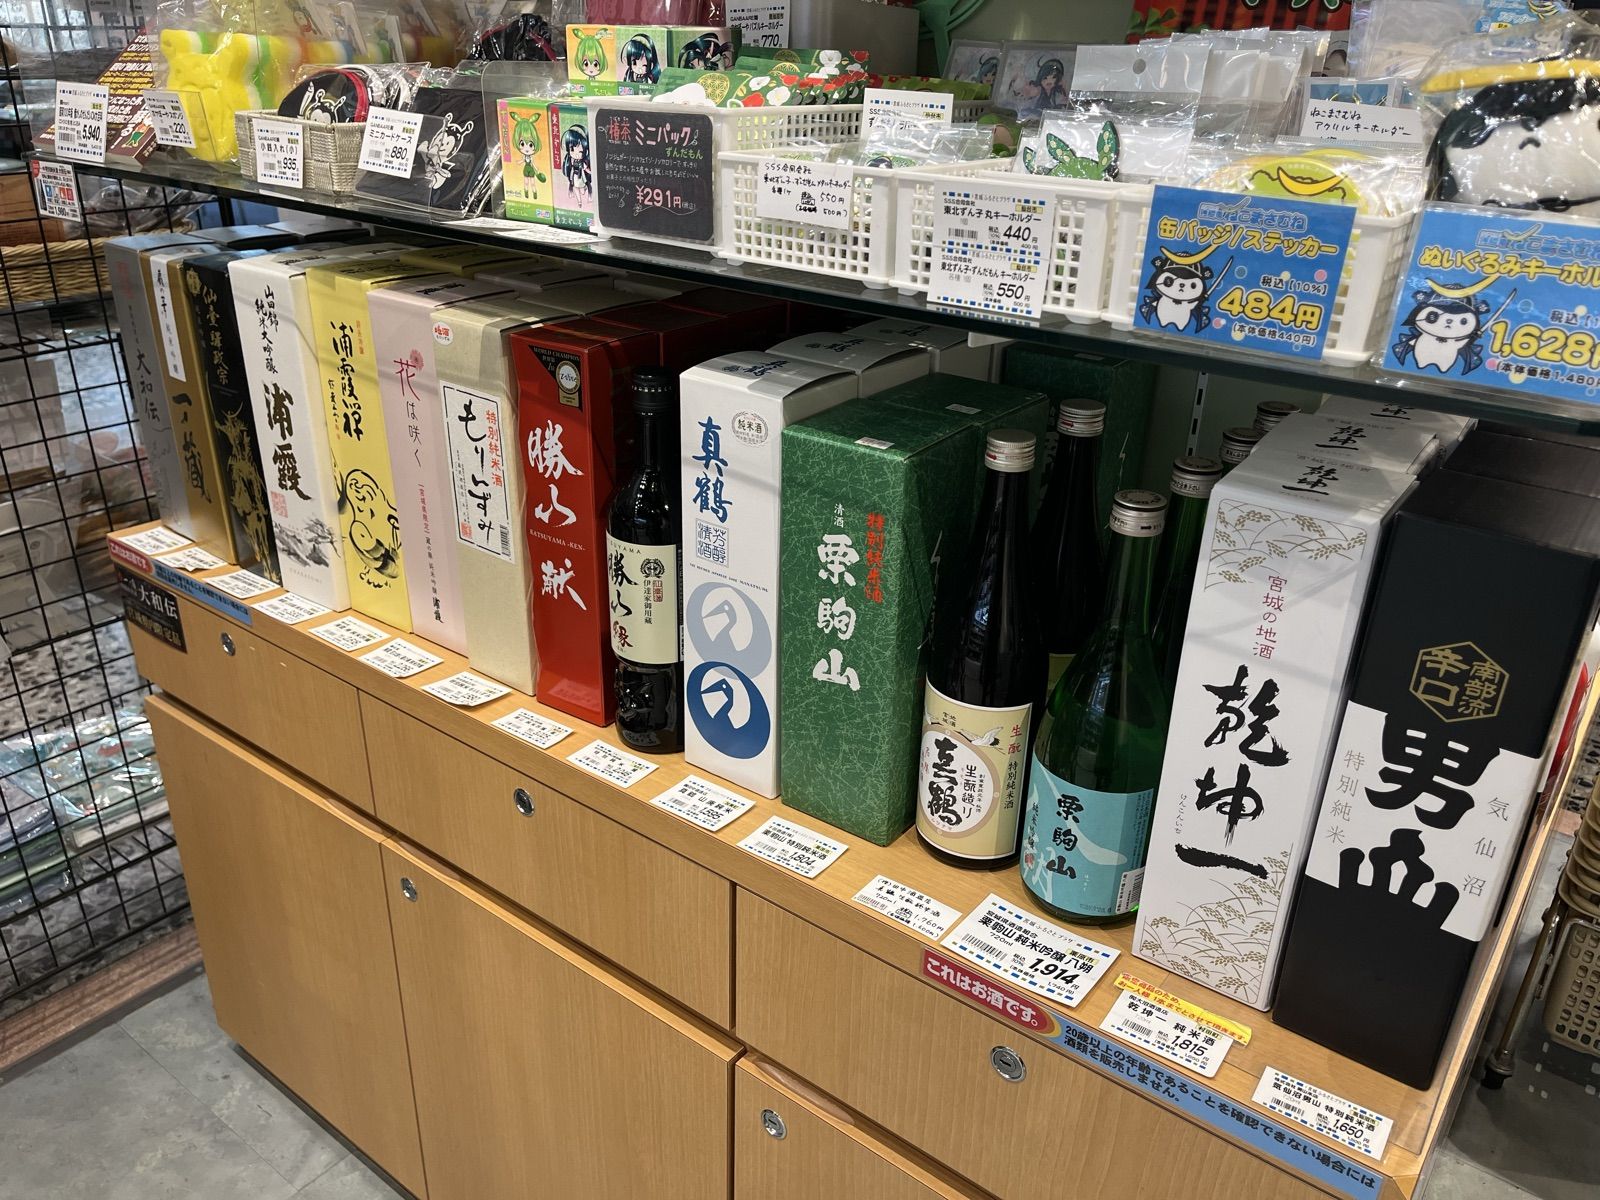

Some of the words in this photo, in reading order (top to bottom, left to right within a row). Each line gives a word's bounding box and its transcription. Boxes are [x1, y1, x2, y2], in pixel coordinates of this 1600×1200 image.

[82, 124, 100, 141] 5,940
[173, 122, 186, 134] 220
[608, 120, 631, 141] 椿茶
[635, 120, 691, 147] ミニパック
[1310, 107, 1361, 120] ねこまさむね
[369, 129, 413, 144] ミニカードケース
[390, 146, 408, 160] 880
[665, 147, 704, 160] ずんだもん
[282, 157, 297, 171] 935
[820, 192, 845, 204] 550円
[943, 205, 984, 219] 東北ずん子
[985, 209, 1042, 223] 丸キーホルダー
[1001, 271, 1035, 281] キーホルダー
[264, 285, 279, 333] 山田錦
[1217, 287, 1323, 331] 484円
[254, 298, 279, 375] 純米大吟醸
[1233, 322, 1316, 346] (本体価格440円)
[136, 351, 161, 422] 大和伝
[393, 358, 422, 468] 花は咲く
[737, 419, 762, 434] 純米酒
[263, 382, 312, 500] 浦霞
[486, 410, 503, 487] 特別純米酒
[527, 420, 584, 528] 勝山
[692, 415, 733, 524] 真鶴
[529, 529, 567, 546] KATSUYAMA
[834, 503, 845, 528] 清酒
[865, 512, 885, 604] 特別純米酒
[139, 584, 178, 620] 大和伝
[812, 533, 861, 691] 栗駒山
[1253, 575, 1288, 660] 宮城の地酒
[1421, 648, 1471, 707] 辛口
[1457, 661, 1501, 718] 南部流
[1003, 761, 1019, 809] 特別純米酒
[1175, 664, 1291, 880] 乾坤一
[699, 807, 724, 820] 1,595
[1327, 749, 1365, 845] 特別純米
[762, 829, 786, 843] 栗駒山
[786, 839, 828, 861] 特別純米酒
[789, 851, 817, 866] 1,804
[1046, 793, 1084, 880] 栗駒山
[1463, 796, 1512, 898] 気仙沼
[978, 915, 1017, 939] 栗駒山
[1013, 933, 1067, 963] 純米吟醸
[1067, 956, 1094, 974] 八朔
[986, 910, 1039, 939] 宮城県酒造組合
[989, 931, 1014, 947] 720ml
[1023, 918, 1075, 944] 宮城ふるさとプラザ
[1069, 950, 1095, 963] 栗原市
[926, 957, 1038, 1027] これはお酒です。
[1127, 1002, 1167, 1022] 乾坤一
[1173, 1022, 1216, 1047] 純米酒
[1199, 1025, 1219, 1039] 村田町
[1063, 1034, 1180, 1102] 酒類を販売しません。
[1065, 1025, 1376, 1189] 20歳以上の年齢であることを確認できない場合には
[1272, 1081, 1321, 1108] 気仙沼男山
[1324, 1104, 1376, 1132] 特別純米酒
